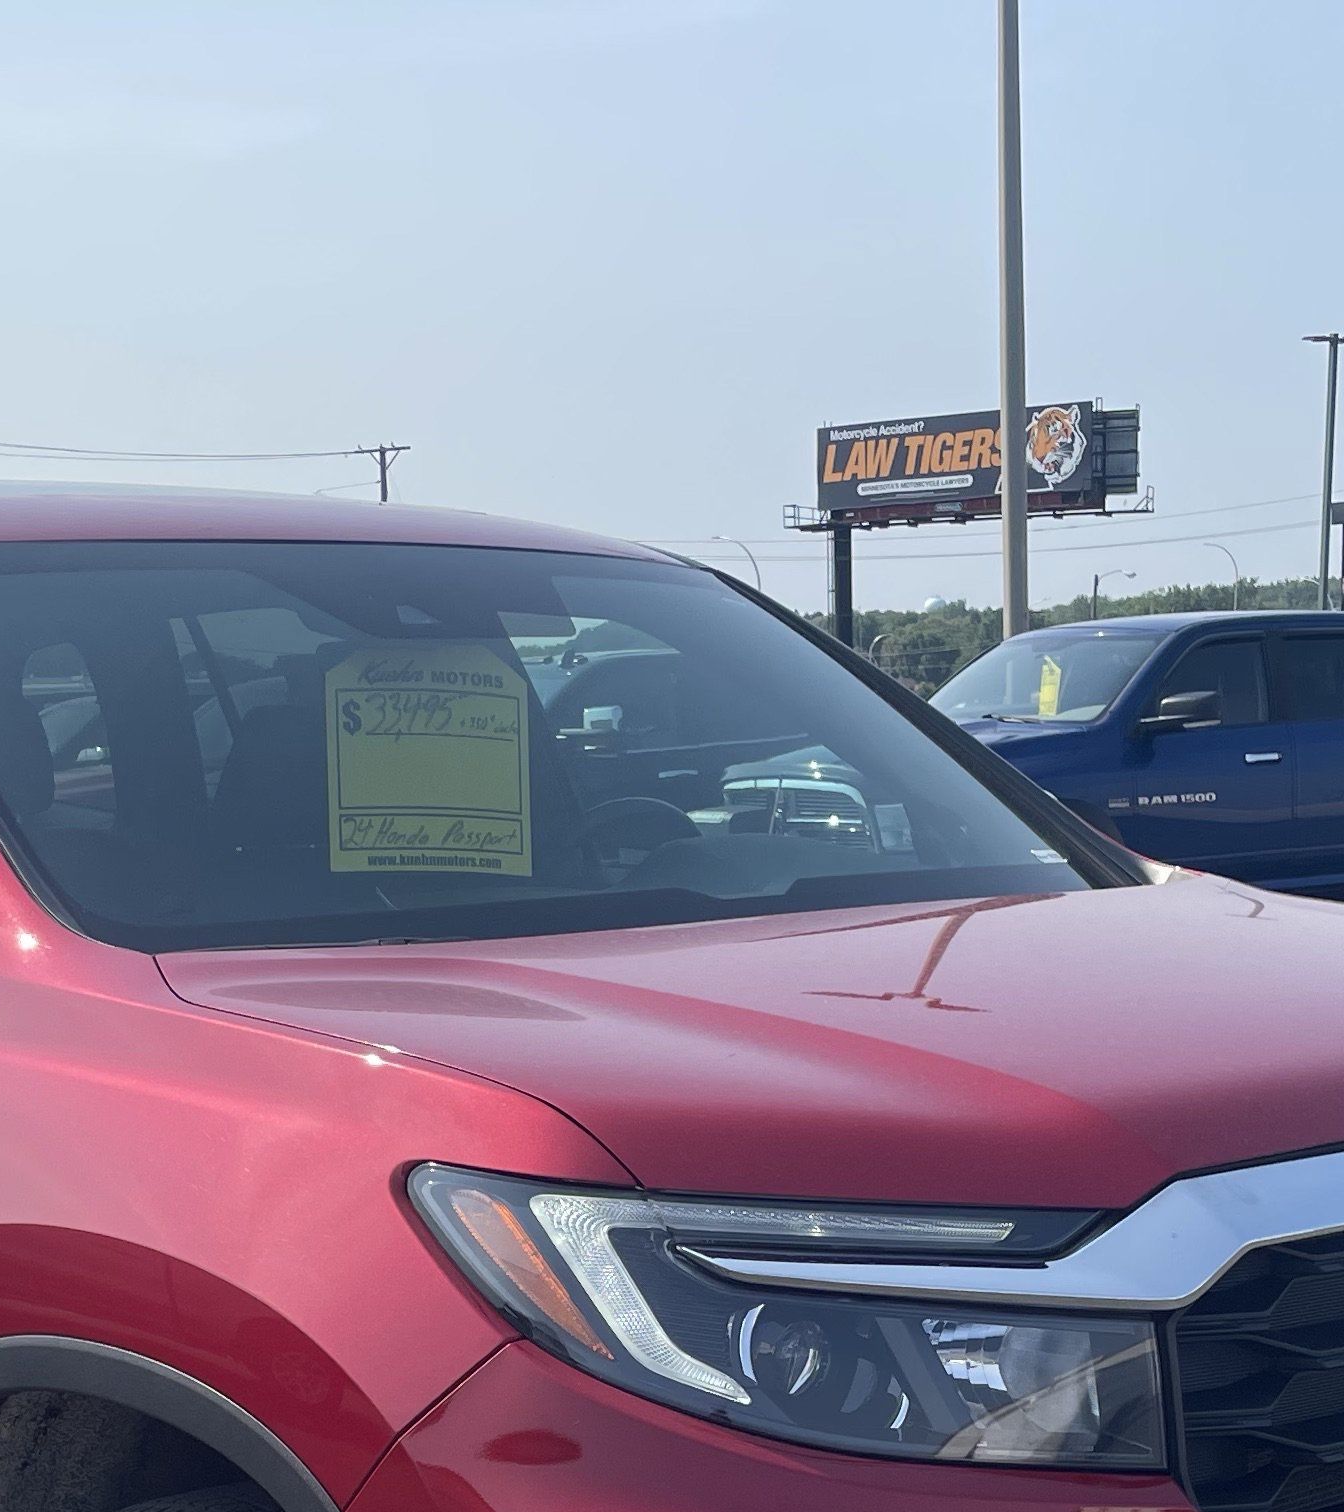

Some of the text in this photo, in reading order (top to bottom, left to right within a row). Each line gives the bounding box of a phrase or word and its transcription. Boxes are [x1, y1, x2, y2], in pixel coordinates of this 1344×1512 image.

[830, 420, 925, 441] Motorcycle Accident?
[823, 437, 900, 483] LAW
[431, 669, 504, 689] MOTORS
[1138, 795, 1178, 806] RAM
[1180, 792, 1216, 803] 1500
